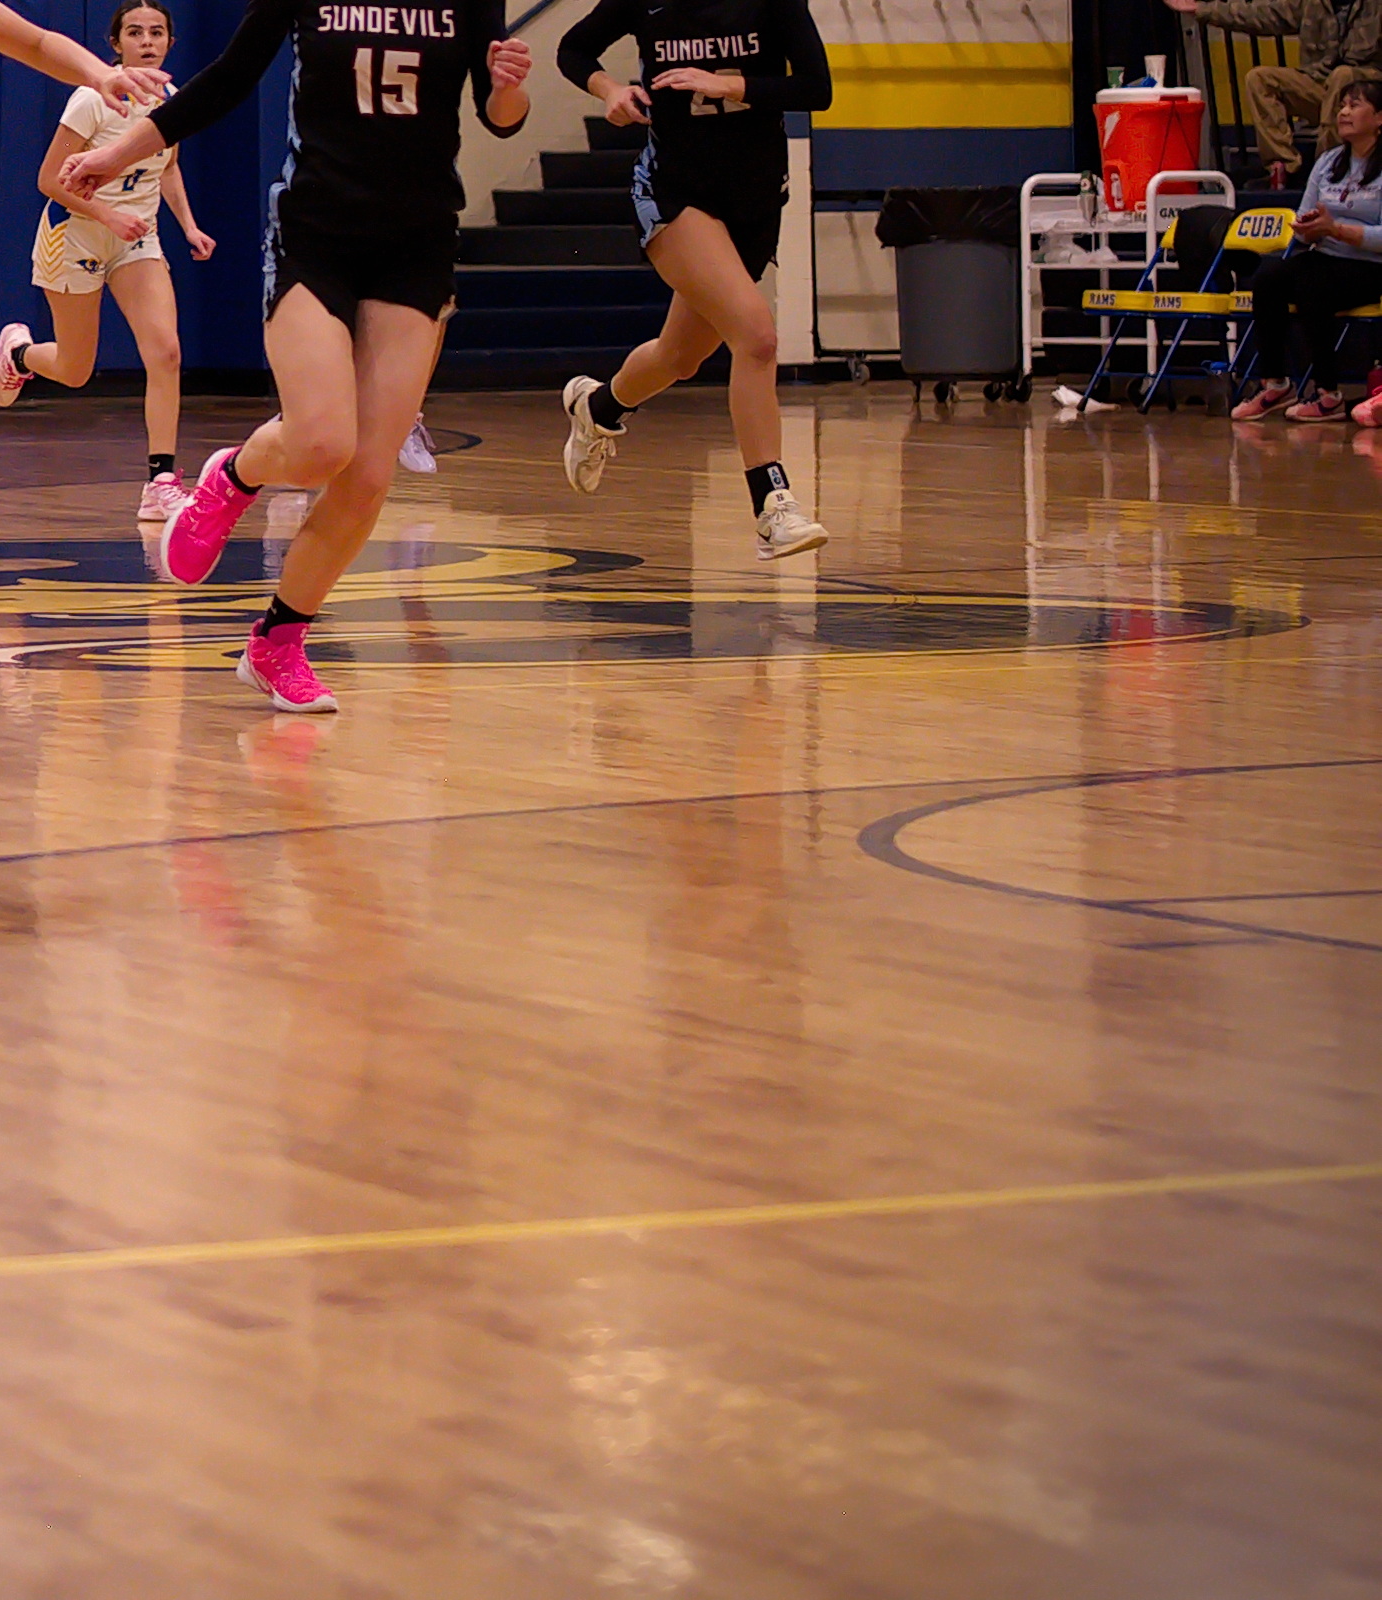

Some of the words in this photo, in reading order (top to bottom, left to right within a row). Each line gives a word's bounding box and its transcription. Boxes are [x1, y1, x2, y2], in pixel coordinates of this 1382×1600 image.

[317, 5, 456, 38] SUNDEVILS
[654, 32, 760, 62] SUNDEVILS
[353, 47, 421, 115] 15
[1237, 215, 1285, 239] CUBA
[1089, 293, 1117, 306] RAMS
[1153, 296, 1183, 309] RAMS
